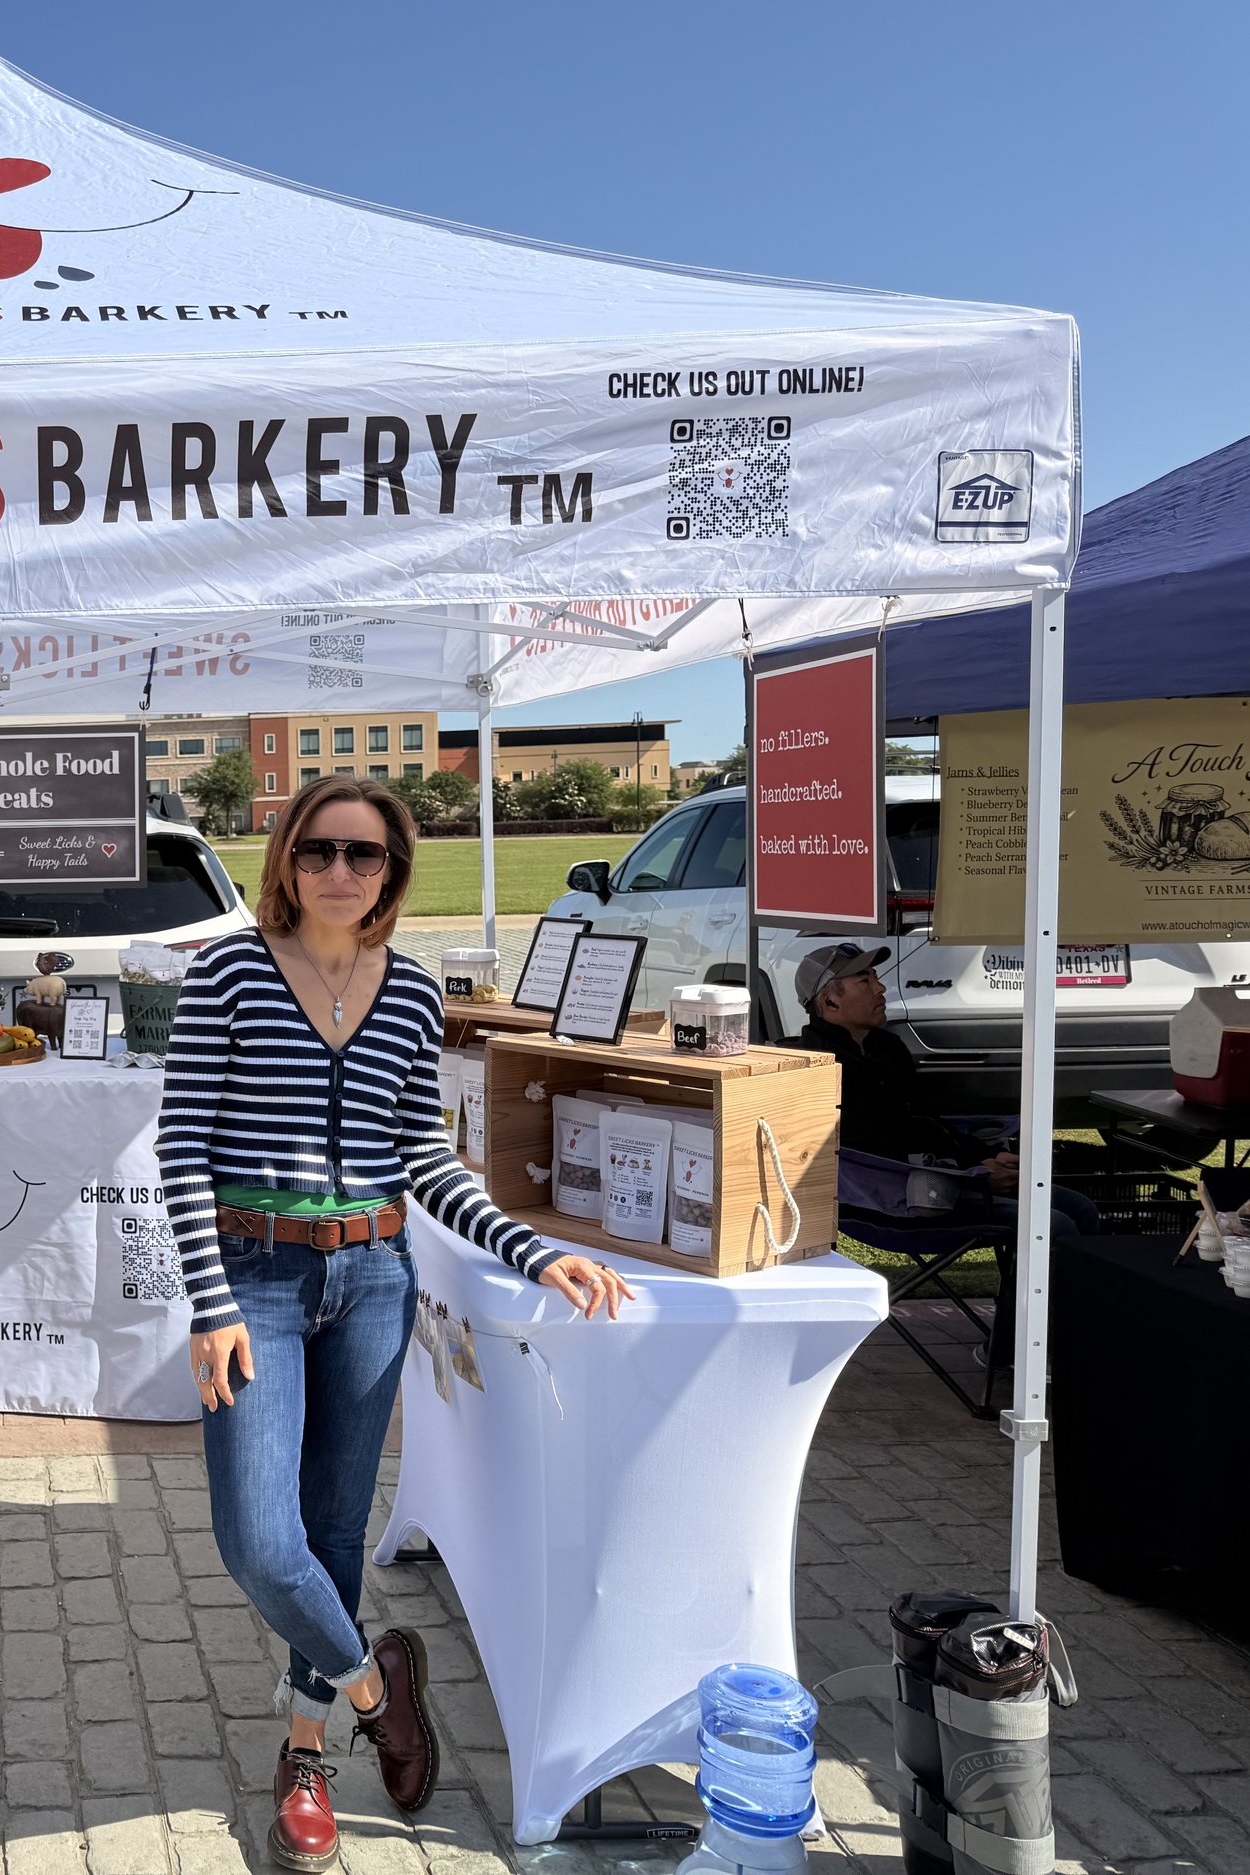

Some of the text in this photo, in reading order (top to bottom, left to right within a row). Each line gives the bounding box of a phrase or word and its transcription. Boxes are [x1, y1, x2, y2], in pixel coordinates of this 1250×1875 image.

[21, 304, 271, 323] BARKERY
[608, 366, 864, 399] CHECK US OUT ONLINE!
[37, 413, 478, 526] BARKERY
[496, 472, 594, 526] TM
[760, 728, 830, 753] no fillers.
[54, 750, 121, 776] Food
[1112, 743, 1245, 785] A Touch
[946, 766, 1020, 779] Jams & Jellies
[760, 779, 842, 804] handcrafted.
[967, 786, 1019, 798] Strawberry
[966, 799, 1013, 811] Blueberry
[965, 812, 1008, 822] Summer
[965, 825, 1006, 838] Tropical
[19, 835, 96, 850] Sweet Licks &
[760, 834, 869, 855] baked with love.
[965, 839, 993, 849] Peach
[27, 852, 89, 870] Happy Tails
[964, 853, 992, 862] Peach
[964, 865, 1006, 876] Seasonal
[1145, 885, 1204, 896] VINTAGE
[1101, 954, 1120, 974] DV
[998, 971, 1014, 980] WITH
[1076, 977, 1102, 985] Retired
[128, 1004, 175, 1021] FARME
[134, 1025, 170, 1041] MAR
[676, 1030, 700, 1045] Beef
[80, 1185, 124, 1204] CHECK
[129, 1186, 149, 1204] US
